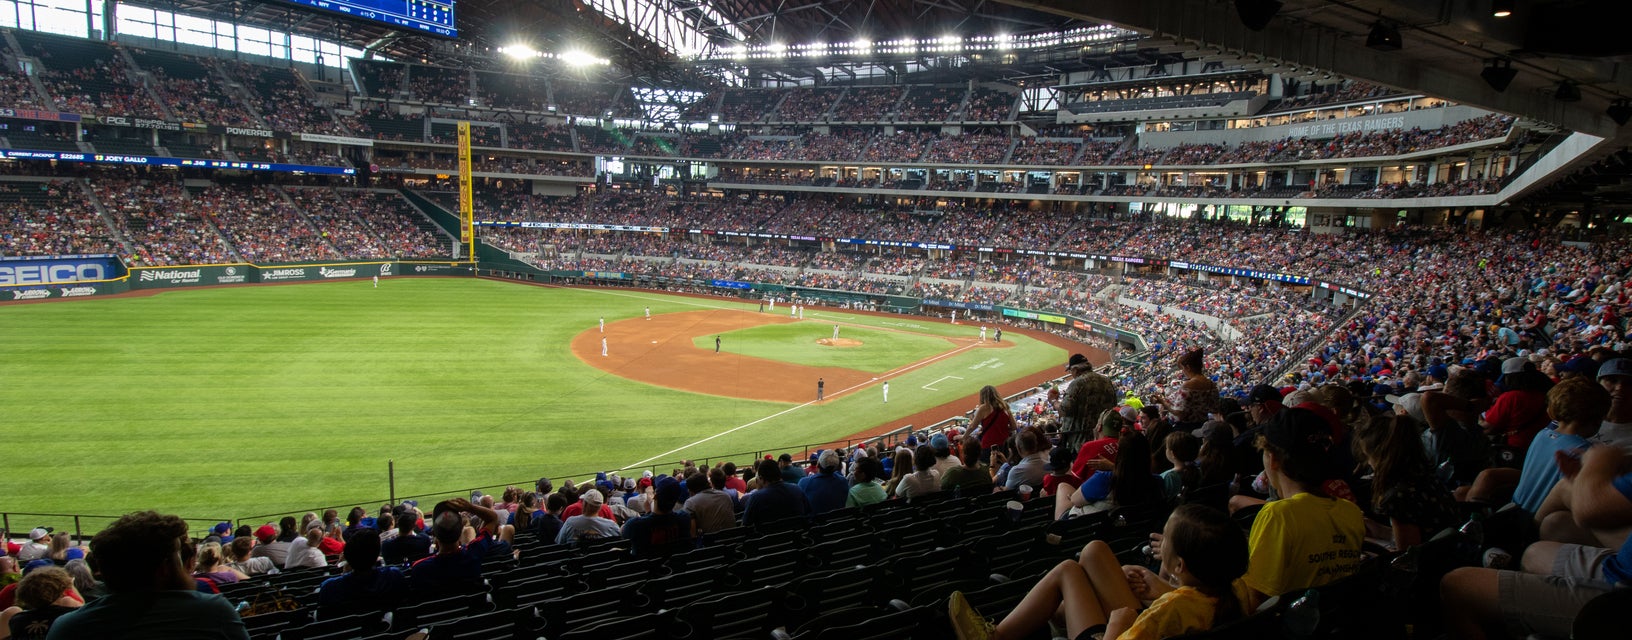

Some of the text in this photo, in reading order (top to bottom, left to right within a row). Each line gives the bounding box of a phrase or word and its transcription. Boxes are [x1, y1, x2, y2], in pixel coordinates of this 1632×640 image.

[107, 116, 130, 126] PGL
[227, 127, 273, 137] POWERADE
[1289, 117, 1404, 137] HOME OF THE TEXAS RANGERS
[0, 264, 104, 284] GEICO
[155, 269, 200, 280] National
